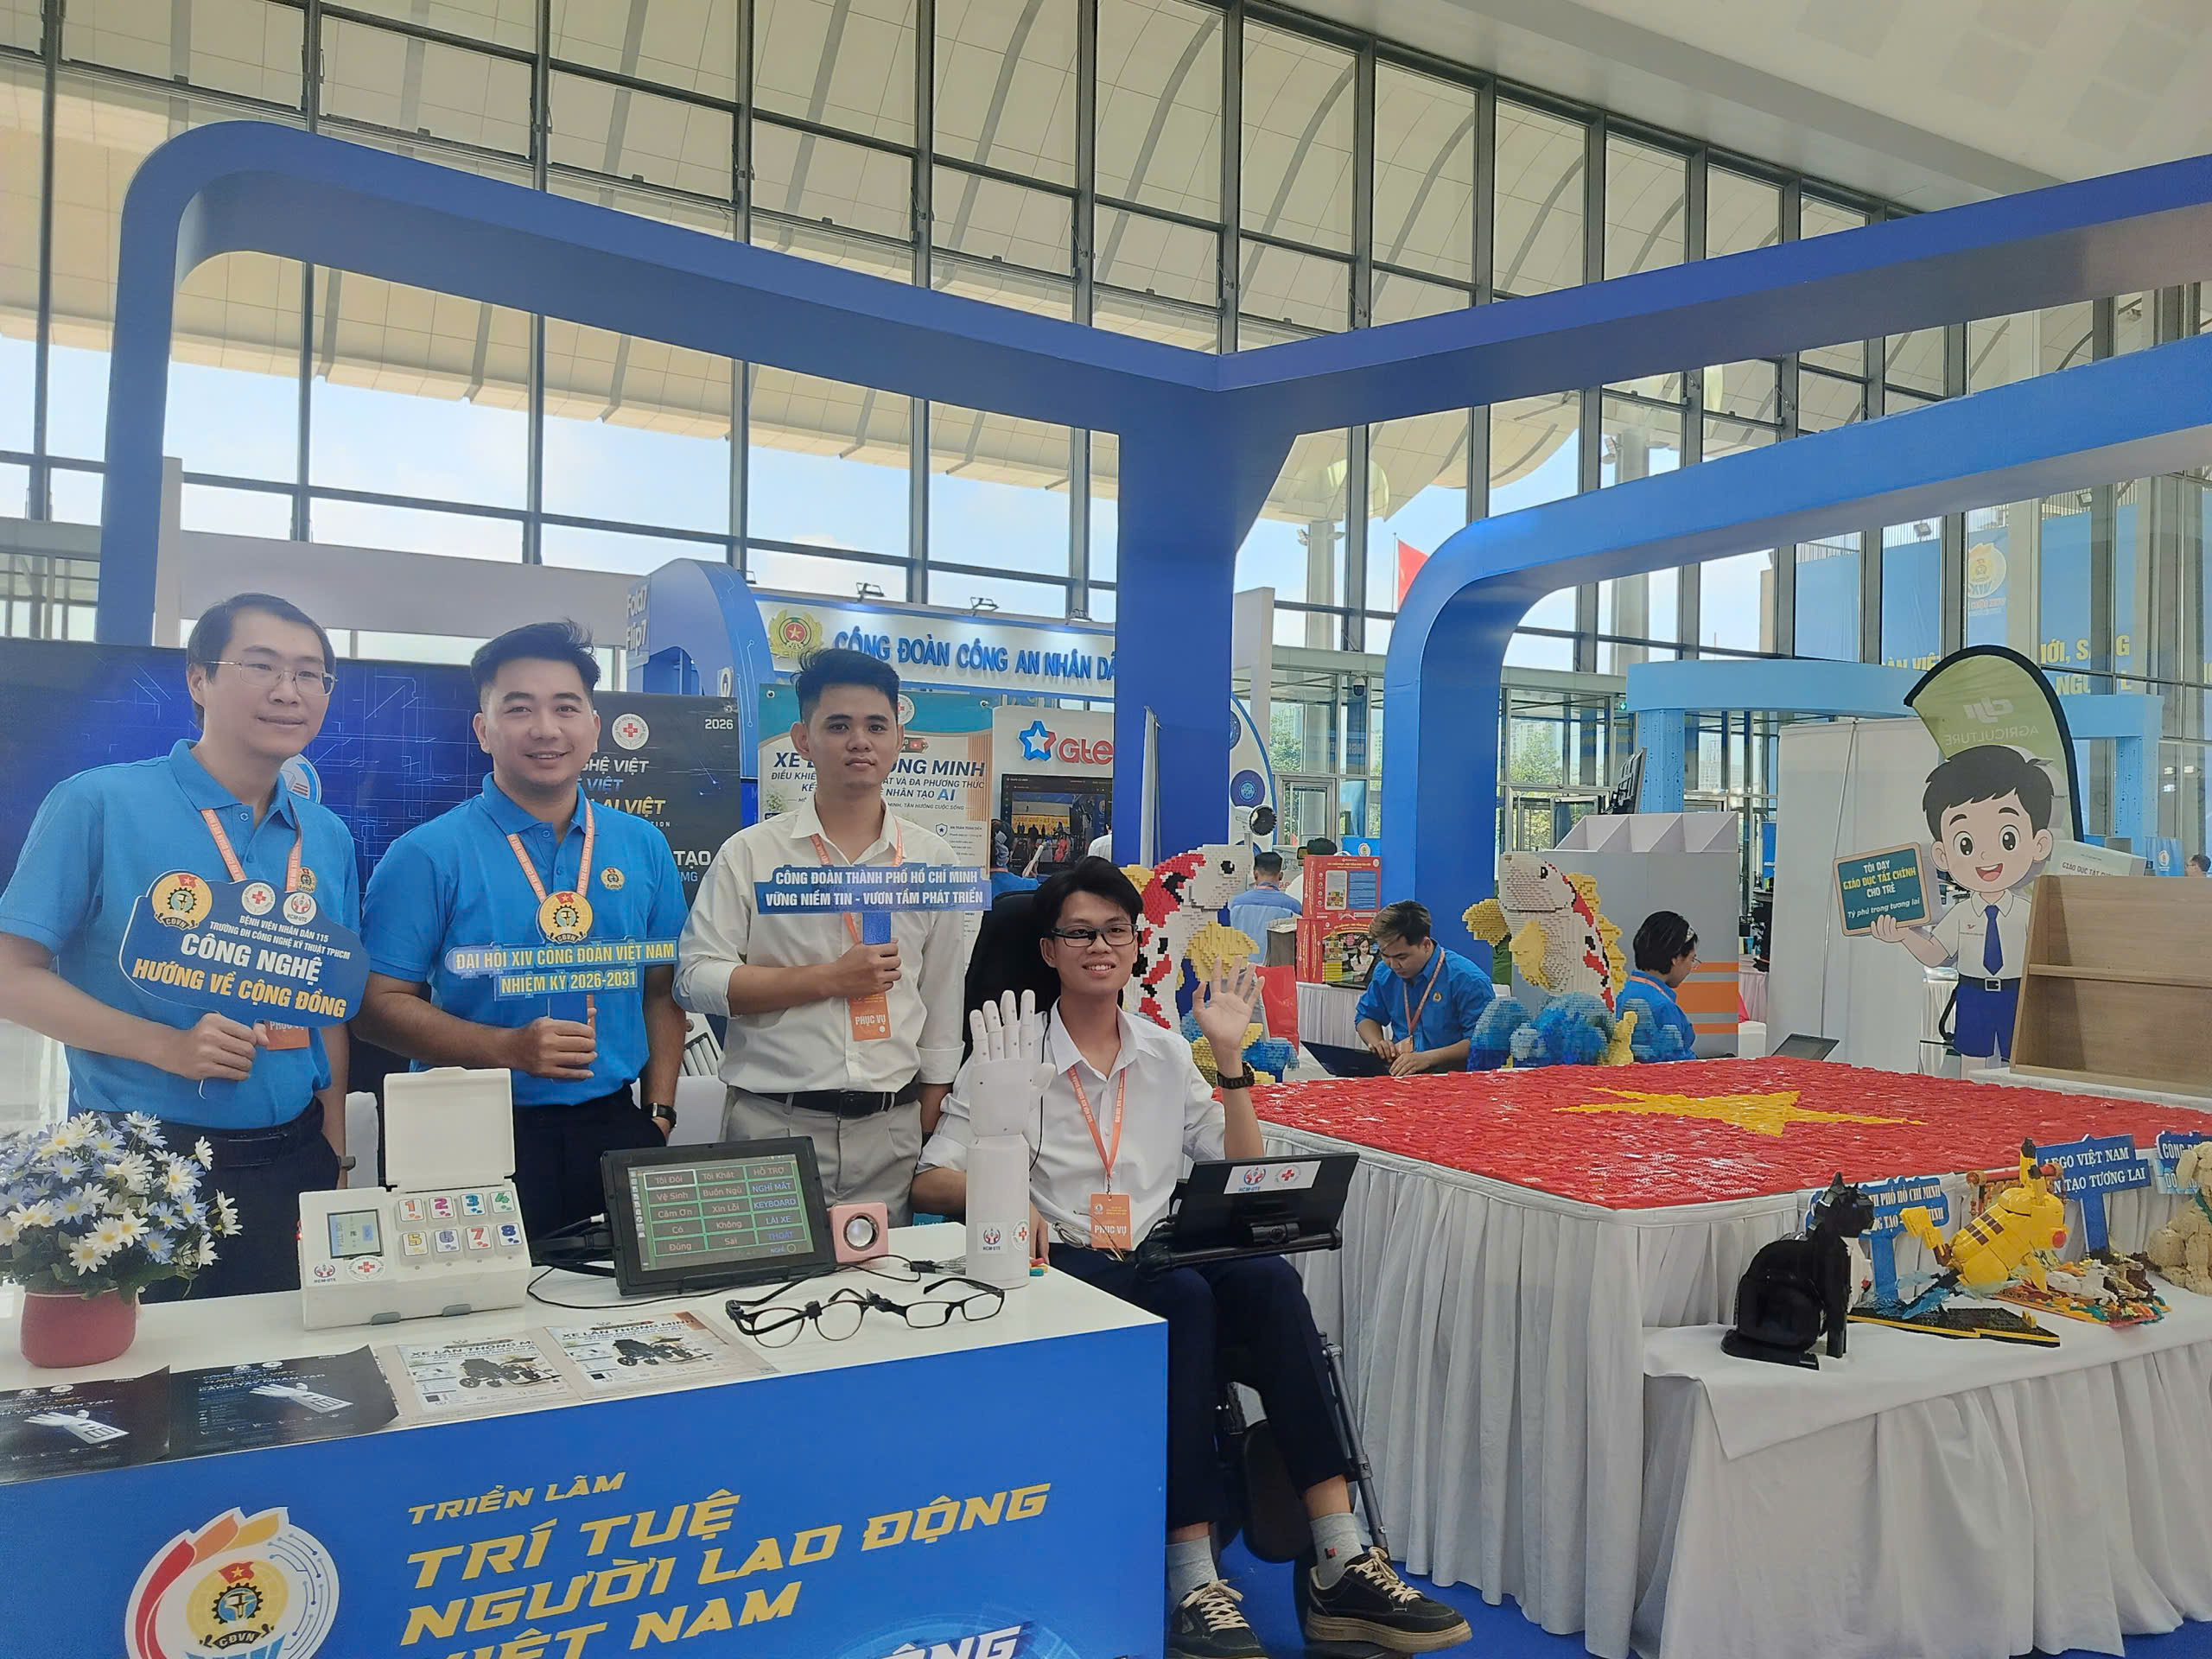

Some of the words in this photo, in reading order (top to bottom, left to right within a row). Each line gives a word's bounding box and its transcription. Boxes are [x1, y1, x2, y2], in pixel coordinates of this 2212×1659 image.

[835, 626, 891, 661] CÔNG
[897, 633, 950, 666] ĐOÀN
[957, 638, 1008, 672] CÔNG
[1015, 650, 1040, 675] AN
[1045, 649, 1090, 680] NHÂN
[1096, 652, 1115, 681] DÂ
[704, 719, 734, 730] 2026
[773, 753, 801, 767] XE
[1058, 738, 1114, 766] Gte
[582, 756, 610, 774] HỆ
[613, 757, 650, 775] VIỆT
[931, 760, 985, 777] MINH
[587, 776, 624, 794] VIỆT
[802, 781, 817, 791] KẾ
[896, 776, 906, 785] VÀ
[923, 779, 960, 788] PHƯƠNG
[962, 779, 985, 789] THỨC
[886, 786, 913, 798] NHÂN
[917, 790, 935, 800] TẠO
[937, 788, 956, 801] AI
[625, 796, 666, 817] VIỆT
[673, 850, 711, 869] TẠO
[1863, 862, 1875, 874] TÔI
[680, 871, 698, 882] MG
[776, 868, 808, 885] CÔNG
[810, 868, 842, 885] ĐOÀN
[846, 868, 883, 884] THÀNH
[885, 865, 908, 884] PHỐ
[911, 865, 925, 883] HỒ
[928, 867, 947, 883] CHÍ
[949, 870, 978, 883] MINH
[1843, 878, 1860, 890] GIÁO
[1862, 875, 1876, 887] DỤC
[1892, 867, 1916, 880] CHÍNH
[766, 889, 798, 906] VỮNG
[800, 887, 830, 906] NIỀM
[833, 892, 853, 905] TIN
[863, 891, 893, 905] VƯƠN
[895, 887, 920, 905] TẦM
[922, 887, 951, 904] PHÁT
[952, 886, 983, 904] TRIỂN
[1866, 887, 1881, 898] CHO
[1871, 904, 1889, 913] trong
[239, 915, 260, 928] BỆNH
[261, 919, 277, 932] VIỆN
[278, 922, 298, 936] NHÂN
[300, 926, 315, 940] DÂN
[315, 932, 329, 943] 115
[209, 920, 238, 936] TRƯỜNG
[240, 928, 251, 938] ĐH
[251, 928, 272, 943] CÔNG
[272, 934, 293, 949] NGHỆ
[303, 940, 327, 955] THUẬT
[327, 947, 351, 960] TPHCM
[180, 932, 251, 967] CÔNG
[256, 949, 323, 986] NGHỆ
[455, 953, 480, 974] ĐẠI
[484, 947, 506, 972] HỘI
[512, 950, 532, 967] XIV
[537, 945, 574, 965] CÔNG
[576, 944, 613, 963] ĐOÀN
[615, 943, 643, 966] VIỆT
[645, 944, 674, 959] NAM
[132, 957, 206, 990] HƯỚNG
[209, 970, 236, 996] VỀ
[238, 979, 292, 1007] CỘNG
[295, 988, 347, 1018] ĐỒNG
[500, 973, 546, 996] NHIỆM
[550, 970, 566, 990] KỲ
[570, 970, 636, 989] 2026-2031
[855, 1014, 875, 1027] PHỤC
[875, 1014, 887, 1026] VỤ
[2075, 1148, 2102, 1167] VIỆT
[2105, 1147, 2129, 1160] NAM
[715, 1171, 735, 1179] Khát
[766, 1166, 785, 1176] TRỢ
[2065, 1176, 2087, 1193] TẠO
[2089, 1170, 2126, 1187] TƯƠNG
[2127, 1167, 2145, 1181] LAI
[655, 1176, 667, 1185] Tôi
[657, 1192, 669, 1202] Vệ
[670, 1192, 689, 1200] Sinh
[1909, 1184, 1922, 1201] CHÍ
[1923, 1185, 1941, 1199] MINH
[404, 1200, 416, 1212] 1
[434, 1198, 448, 1210] 2
[465, 1194, 480, 1207] 3
[494, 1192, 510, 1204] 4
[753, 1198, 797, 1209] KEYBOARD
[671, 1225, 684, 1234] Có
[715, 1220, 742, 1230] Không
[766, 1216, 779, 1225] LÁI
[1884, 1215, 1898, 1233] TẠO
[407, 1233, 422, 1246] 5
[439, 1230, 454, 1243] 6
[471, 1227, 484, 1240] 7
[501, 1224, 517, 1236] 8
[1116, 1225, 1128, 1236] VỤ
[668, 1243, 692, 1252] Đúng
[408, 1484, 533, 1526] TRIỂN
[545, 1471, 626, 1503] LÃM
[408, 1518, 559, 1589] TRÍ
[580, 1488, 741, 1556] TUỆ
[400, 1556, 677, 1647] NGƯỜI
[697, 1524, 842, 1586] LAO
[861, 1482, 1052, 1552] ĐỘNG
[629, 1580, 802, 1650] NAM
